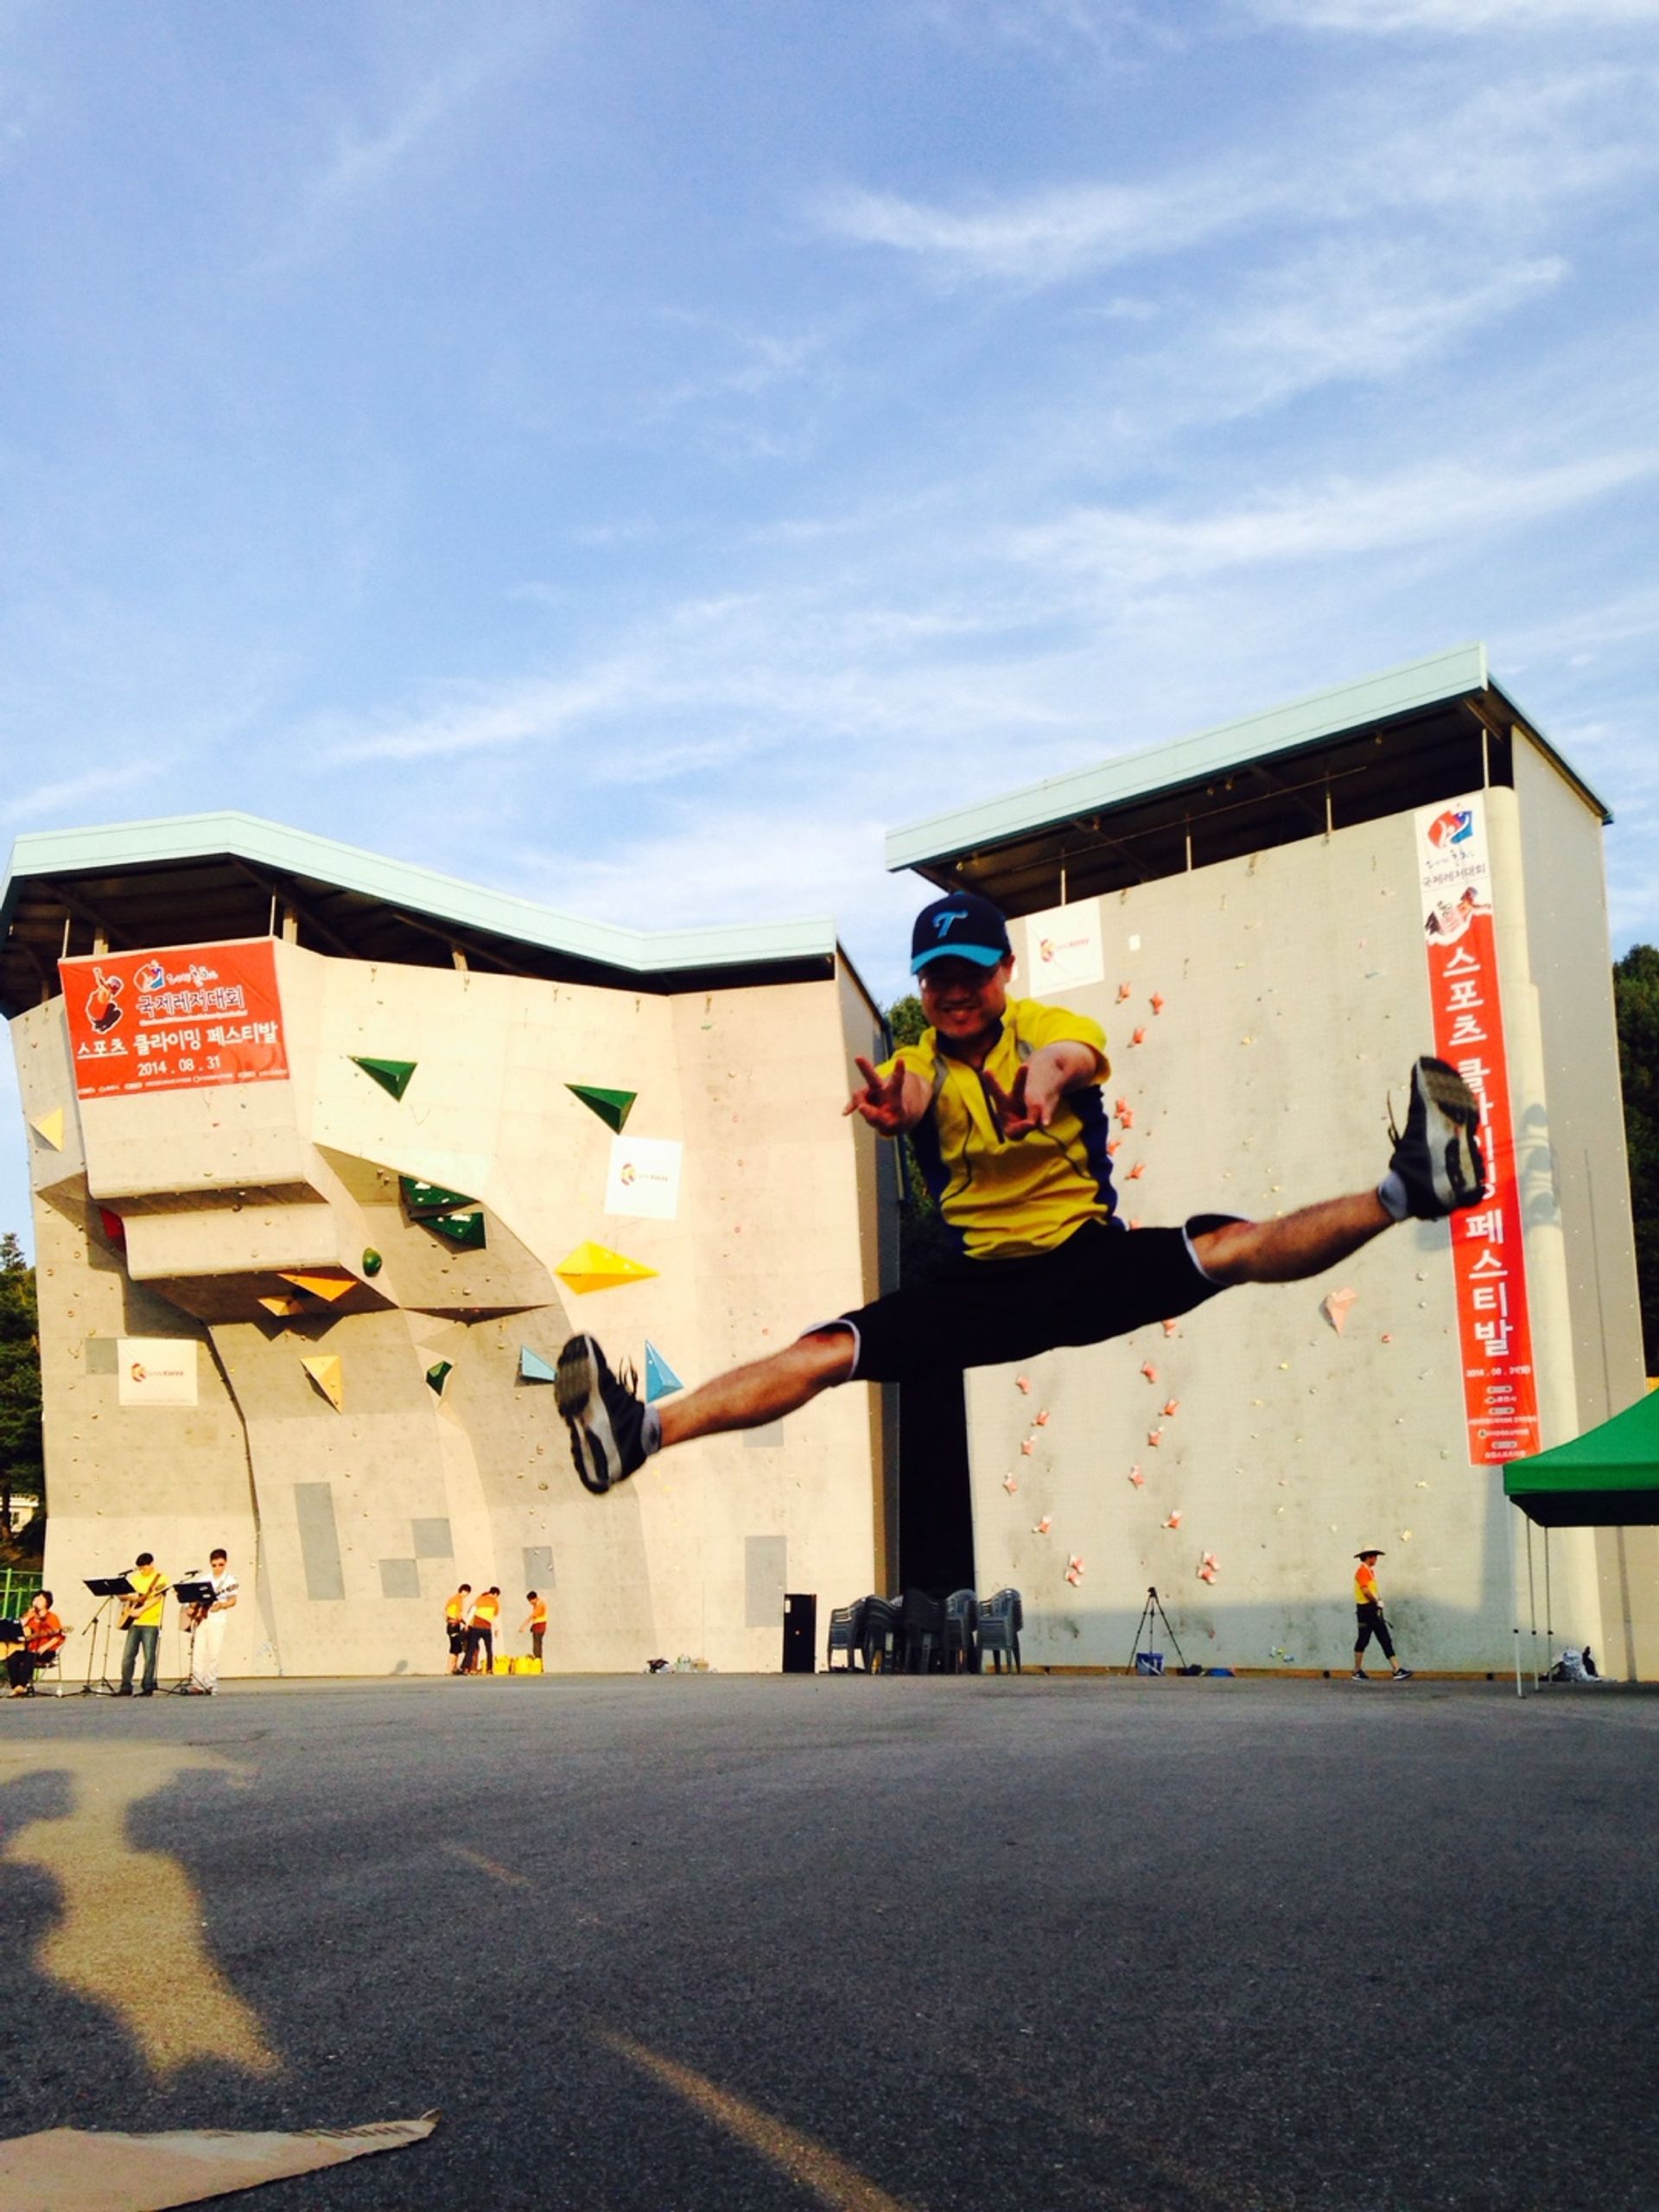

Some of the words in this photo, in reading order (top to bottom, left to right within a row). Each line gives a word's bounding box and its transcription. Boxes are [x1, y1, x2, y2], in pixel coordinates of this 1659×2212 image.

[932, 910, 968, 938] T
[136, 985, 245, 1018] 국제레저대회
[77, 1038, 129, 1059] 스포츠
[133, 1027, 201, 1055] 클라이밍
[207, 1022, 278, 1048] 페스티발
[1442, 947, 1487, 1046] 스포츠
[1465, 1209, 1514, 1357] 페스티발
